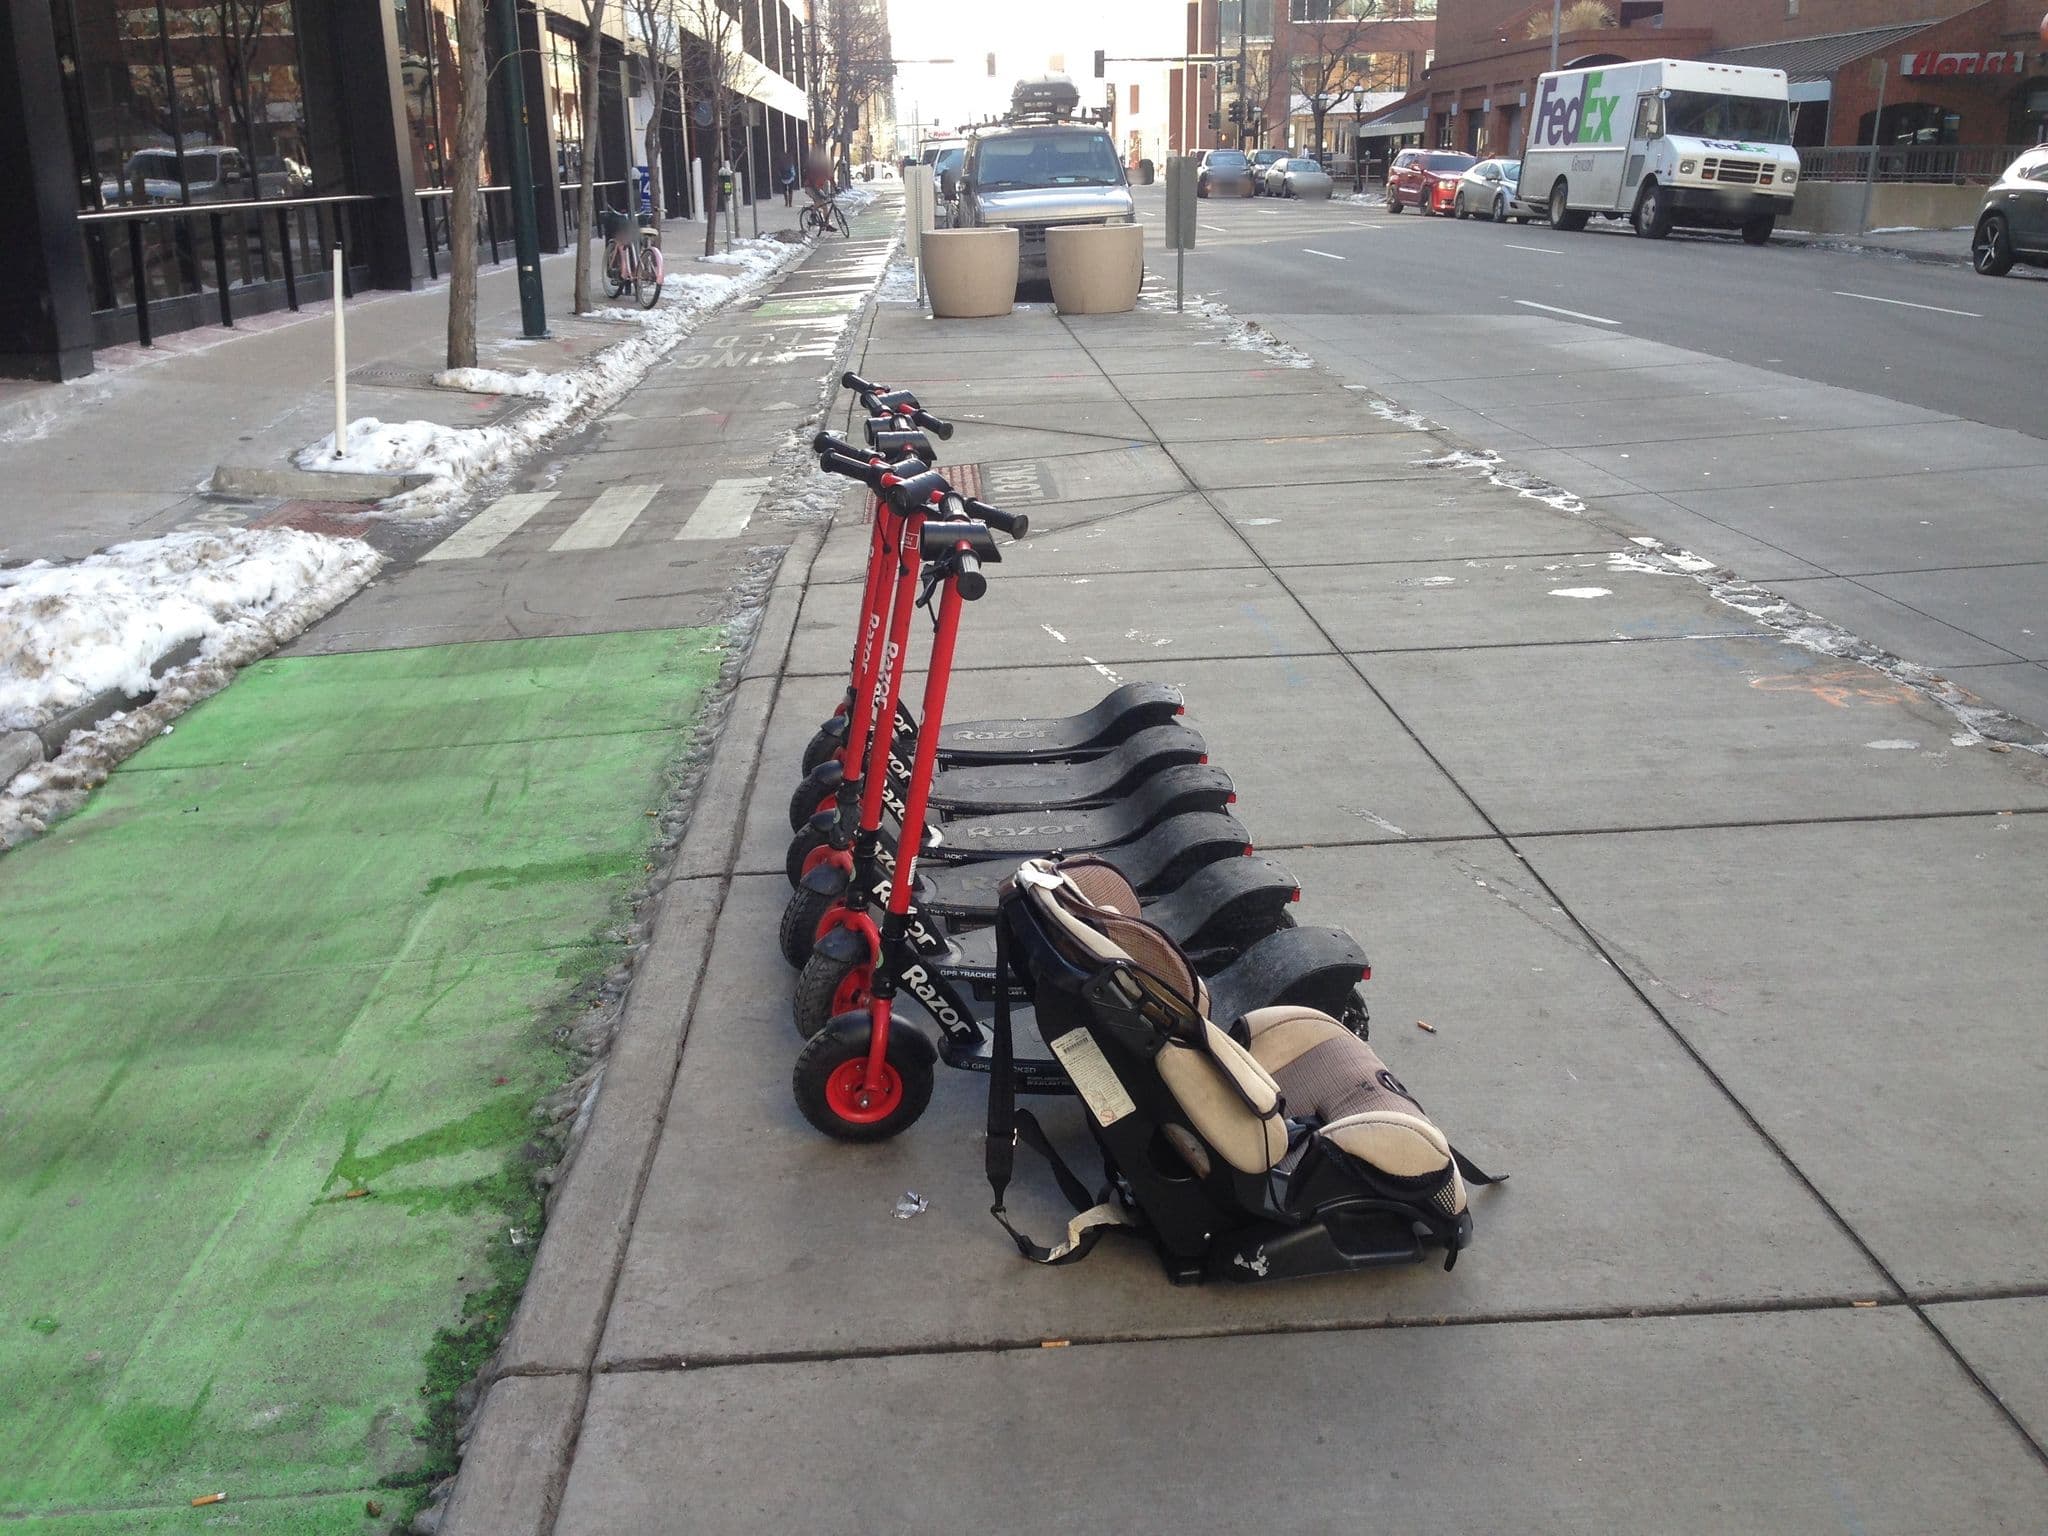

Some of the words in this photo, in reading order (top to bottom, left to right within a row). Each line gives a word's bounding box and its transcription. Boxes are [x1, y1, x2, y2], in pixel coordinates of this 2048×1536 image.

[1912, 48, 2018, 77] florist
[1534, 71, 1620, 146] FedEx
[1701, 140, 1769, 153] FedEx
[878, 641, 899, 710] Razor
[953, 729, 1054, 741] Razor
[960, 777, 1066, 790] Razor
[967, 825, 1085, 839] Razor
[901, 964, 971, 1034] Razor
